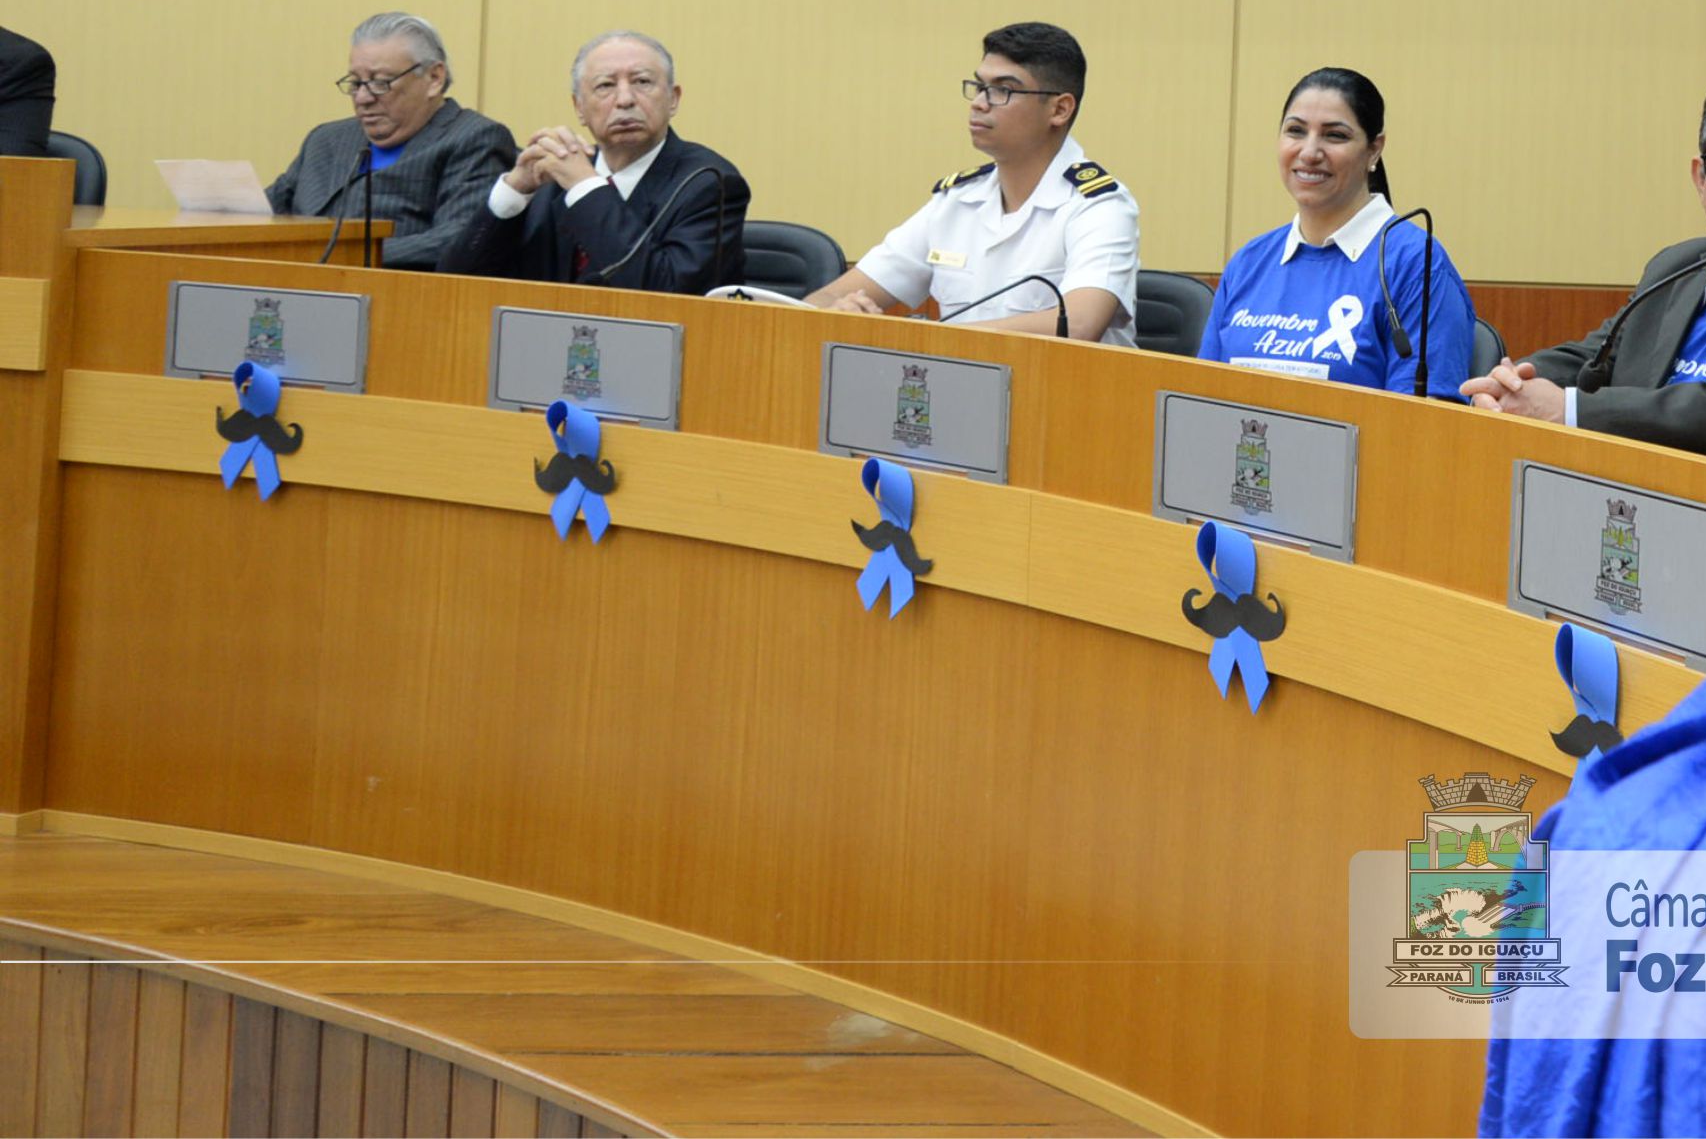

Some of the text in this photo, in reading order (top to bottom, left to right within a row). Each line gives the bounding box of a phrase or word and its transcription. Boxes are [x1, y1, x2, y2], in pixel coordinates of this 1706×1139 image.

[1230, 308, 1319, 332] Novembro
[1253, 329, 1314, 357] Azul
[1320, 350, 1342, 361] 2019
